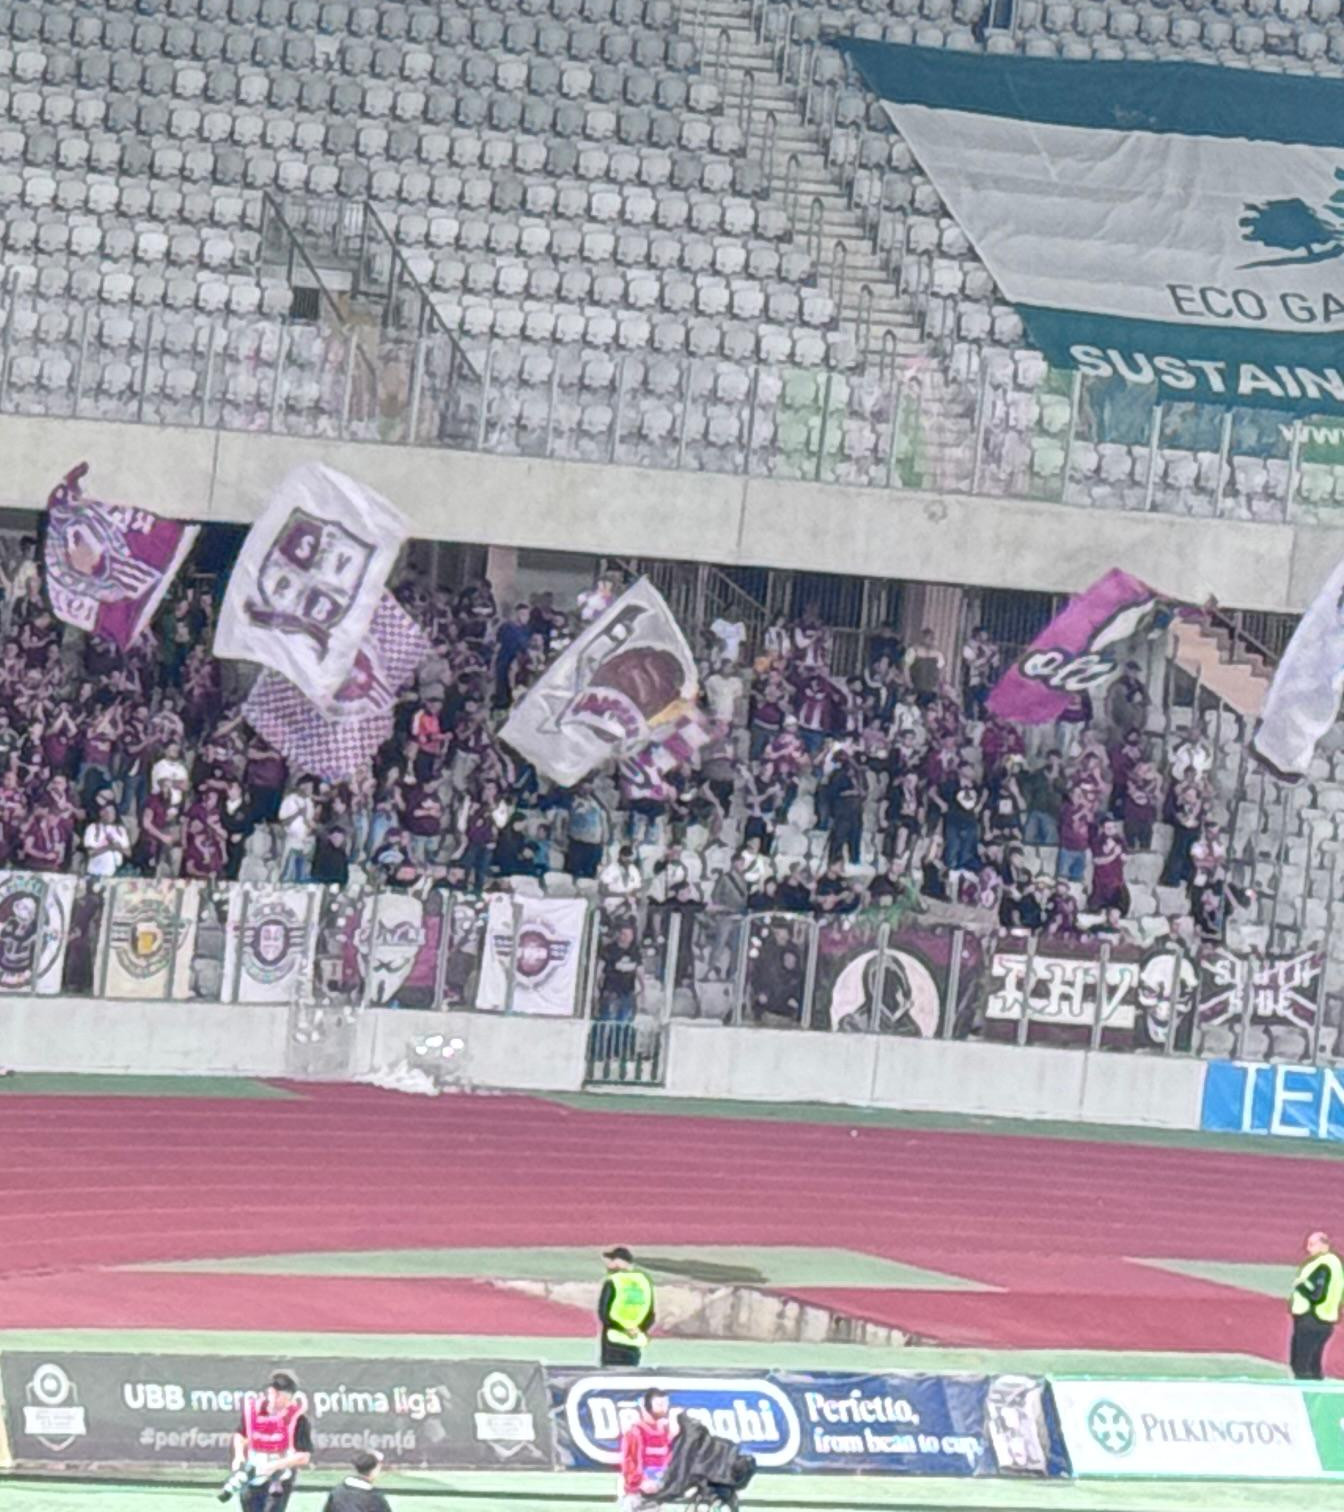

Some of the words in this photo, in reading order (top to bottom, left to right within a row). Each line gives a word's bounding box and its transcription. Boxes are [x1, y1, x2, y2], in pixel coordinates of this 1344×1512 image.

[1166, 284, 1267, 321] ECO
[1069, 345, 1344, 402] SUSTAIN
[294, 535, 315, 558] S
[123, 1384, 186, 1411] UBB
[315, 1385, 390, 1418] prima
[393, 1386, 443, 1420] ligă
[139, 1427, 233, 1451] #perform
[311, 1427, 417, 1451] excelență
[814, 1427, 864, 1454] from
[864, 1427, 917, 1454] bean
[918, 1434, 940, 1454] to
